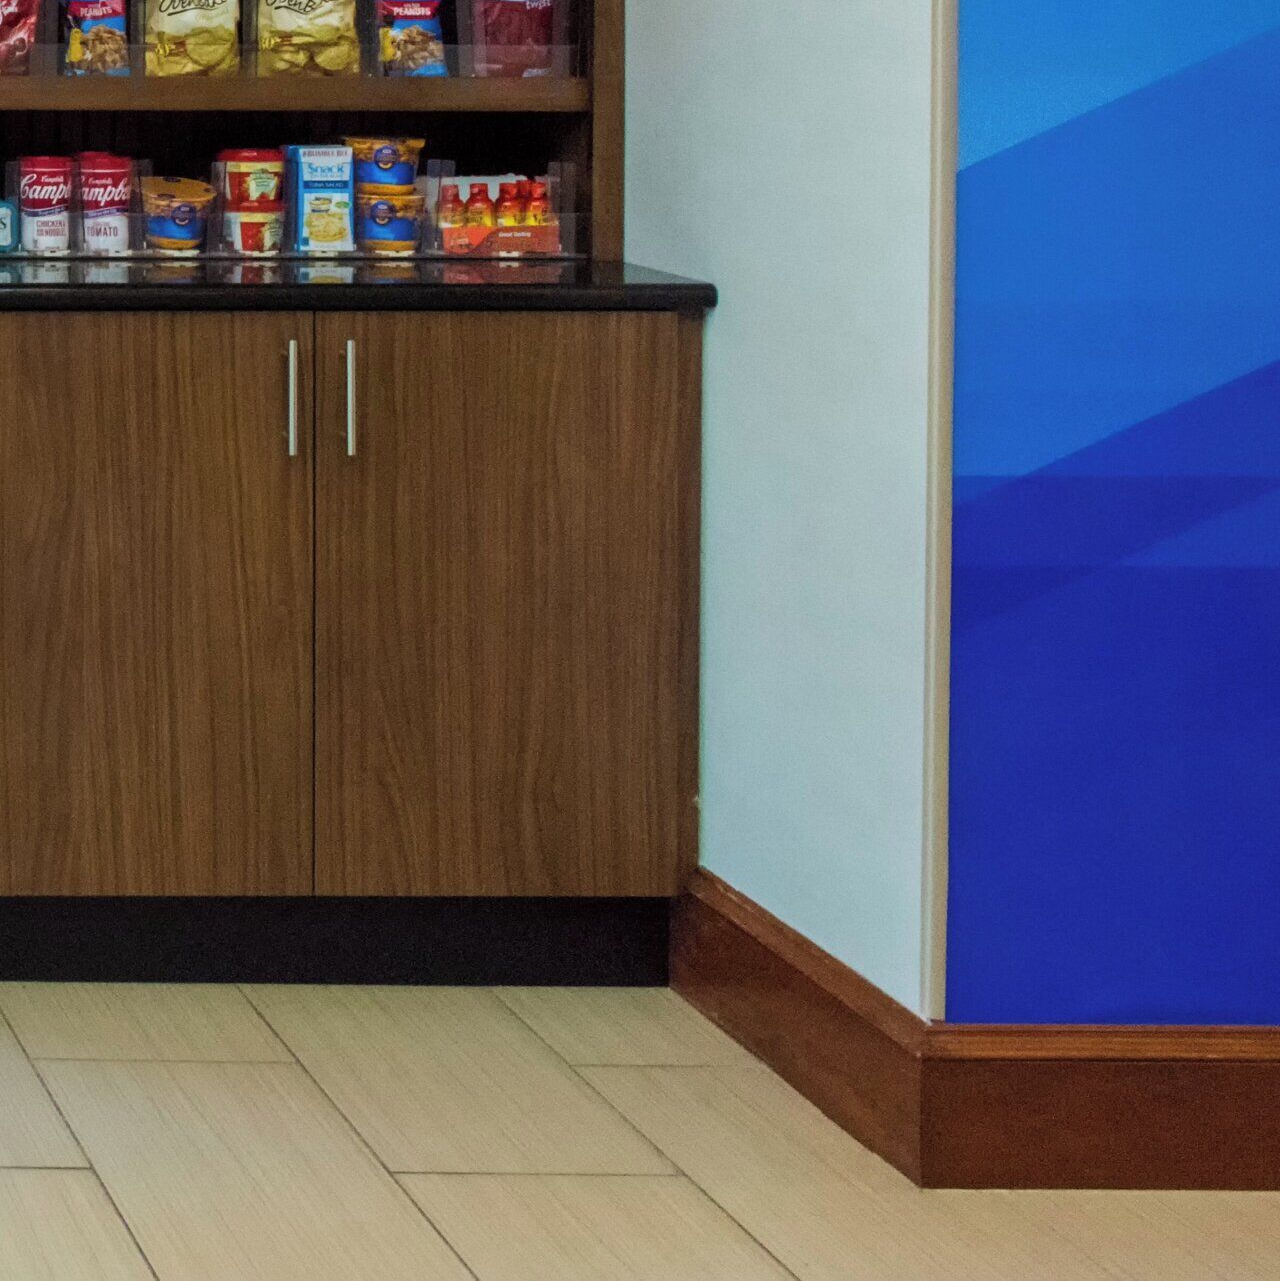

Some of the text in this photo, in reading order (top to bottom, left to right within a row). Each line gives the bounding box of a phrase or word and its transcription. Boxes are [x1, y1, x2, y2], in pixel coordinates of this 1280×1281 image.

[80, 6, 112, 17] PEANUTS
[393, 5, 431, 16] PEANUTS
[87, 226, 119, 237] TOMATO
